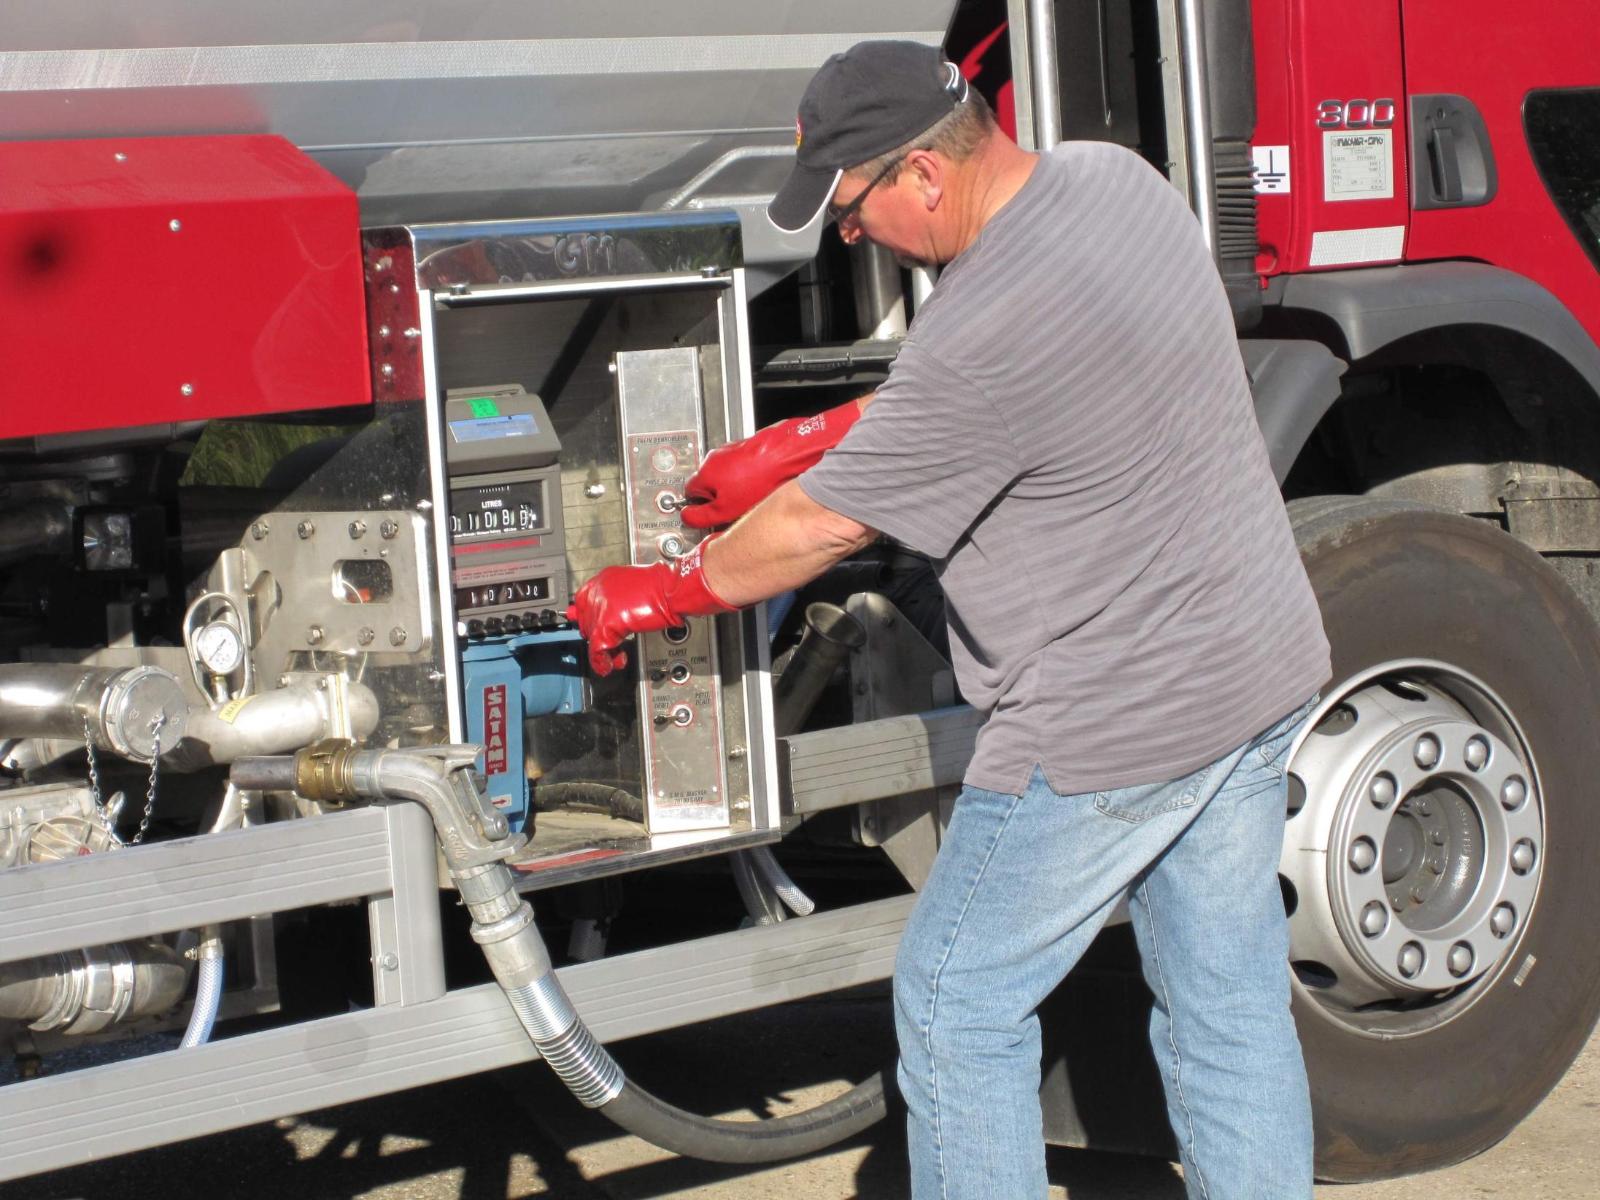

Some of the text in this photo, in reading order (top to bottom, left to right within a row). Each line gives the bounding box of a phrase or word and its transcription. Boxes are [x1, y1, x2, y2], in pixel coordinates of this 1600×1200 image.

[1316, 98, 1394, 128] 300
[481, 500, 503, 509] LITRES
[487, 691, 503, 763] SATAM
